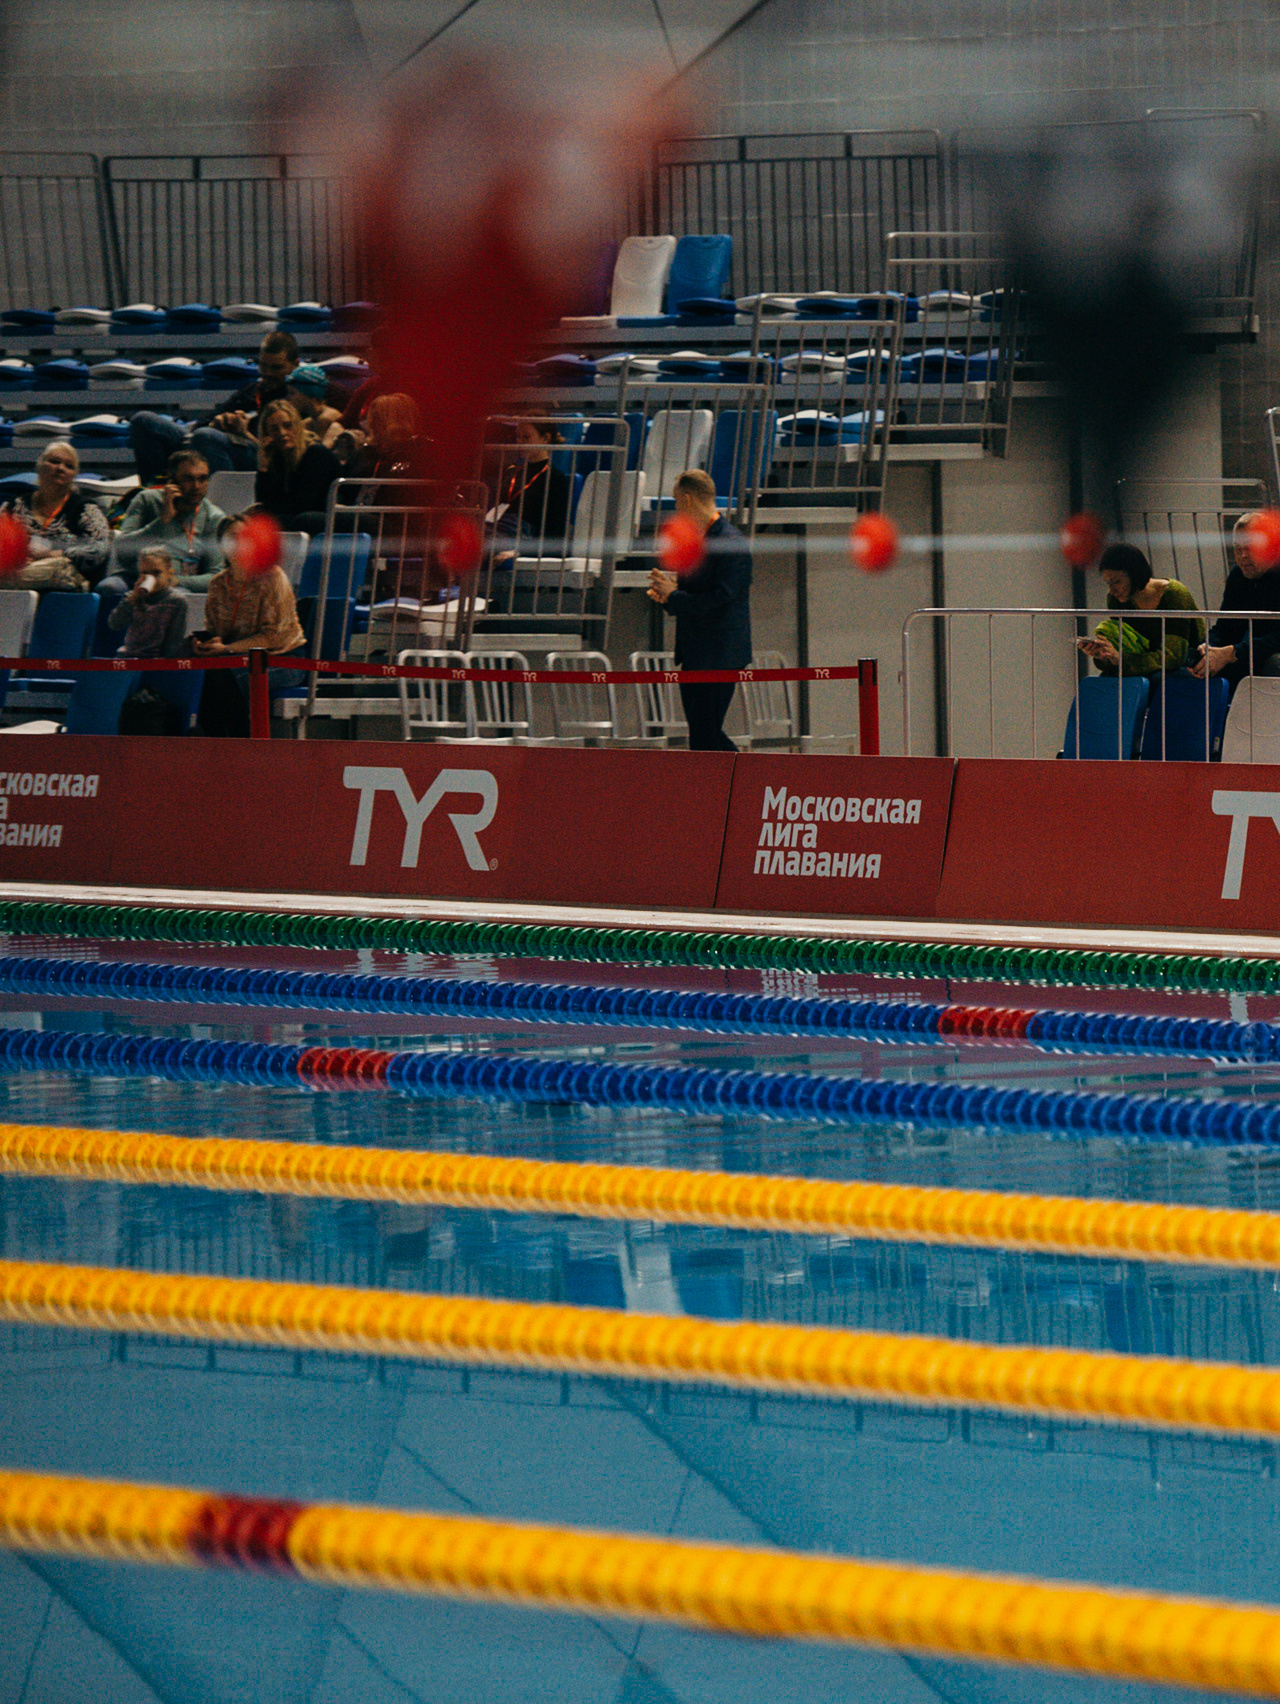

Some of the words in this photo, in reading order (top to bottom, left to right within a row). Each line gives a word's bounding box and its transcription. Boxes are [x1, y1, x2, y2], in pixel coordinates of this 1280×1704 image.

[177, 660, 192, 669] TYR
[382, 665, 397, 676] TYR
[451, 669, 466, 680] TYR
[738, 671, 753, 681] TYR
[815, 669, 830, 679] TYR
[522, 672, 537, 682] TYR
[592, 672, 607, 683] TYR
[664, 672, 679, 682] TYR
[0, 771, 99, 797] сковская
[761, 786, 922, 824] Московская
[342, 765, 499, 872] TYR
[757, 822, 818, 848] лига
[753, 849, 882, 878] плавания
